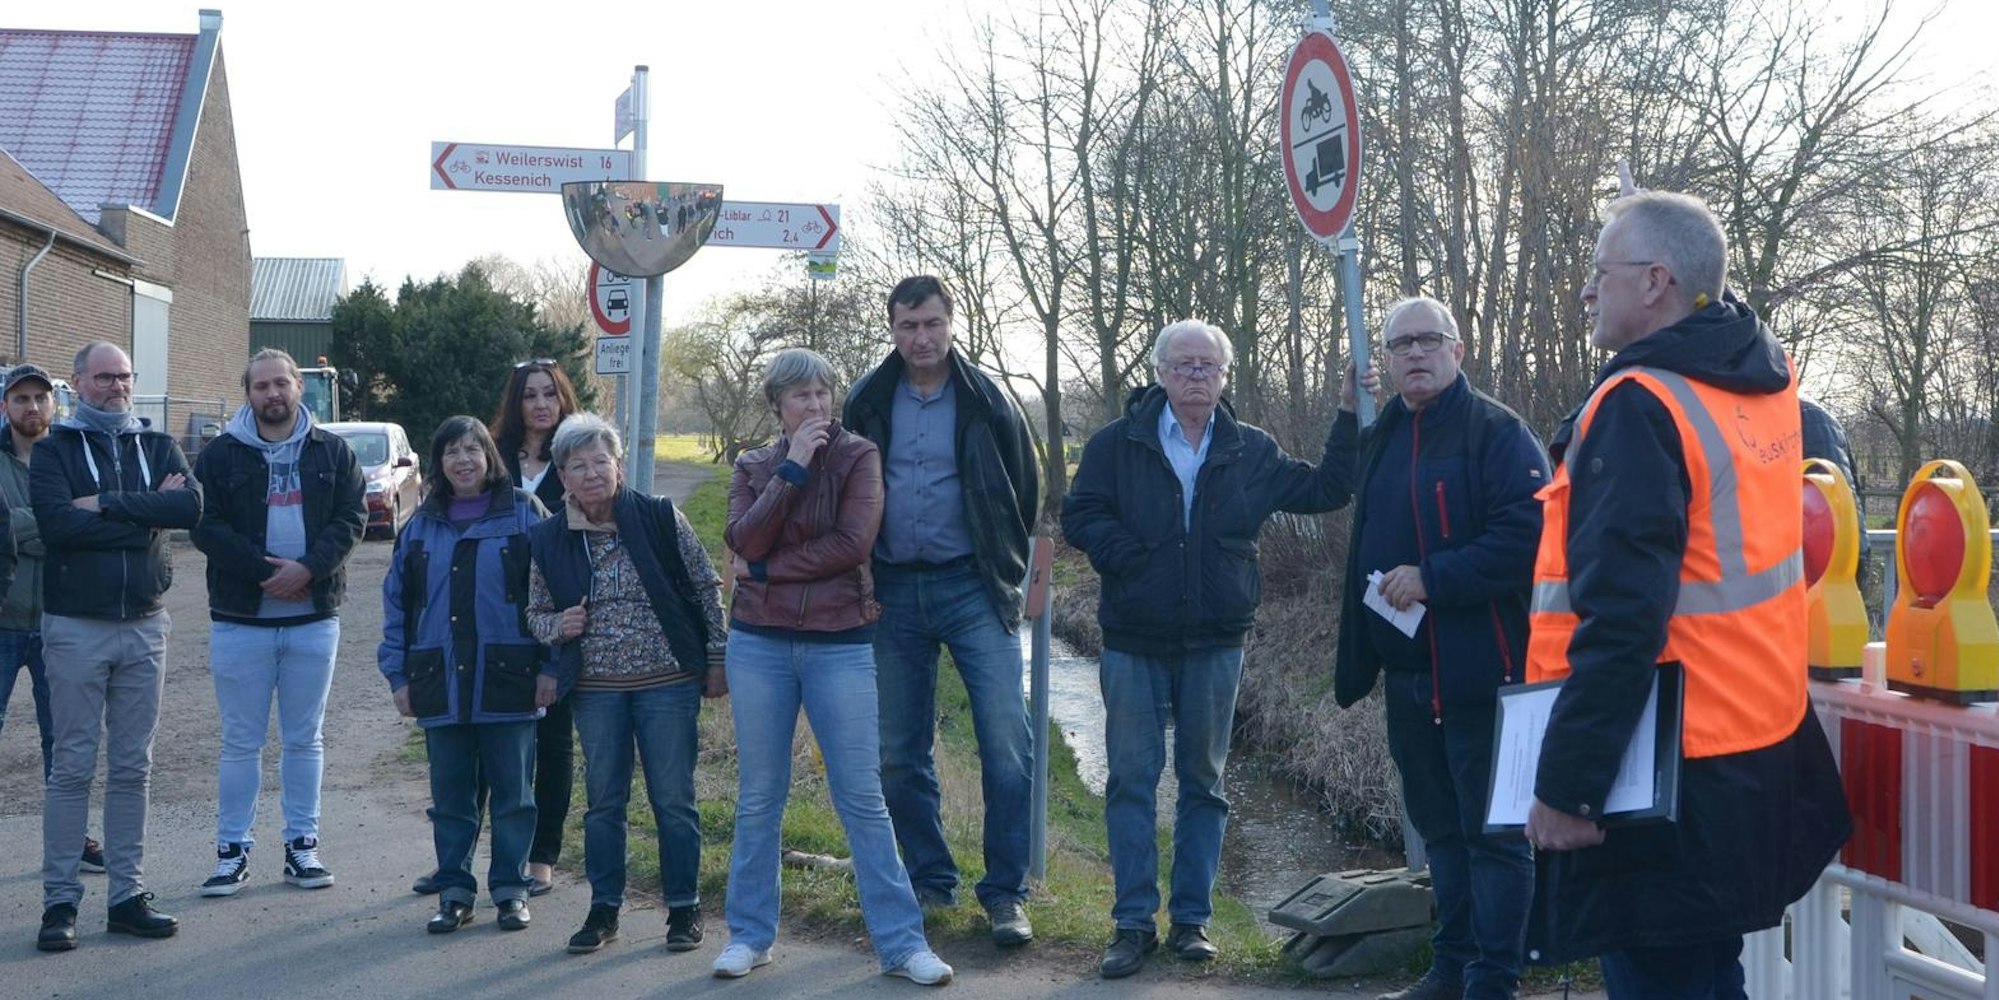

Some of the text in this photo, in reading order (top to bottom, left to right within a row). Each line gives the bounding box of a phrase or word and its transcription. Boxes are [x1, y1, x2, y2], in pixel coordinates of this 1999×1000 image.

[496, 152, 612, 169] Weilerswist 16
[474, 170, 551, 187] Kessenich
[718, 209, 790, 223] -Liblar 21
[714, 227, 799, 243] ich 2,4
[600, 343, 630, 356] Anliege
[610, 357, 624, 368] frei
